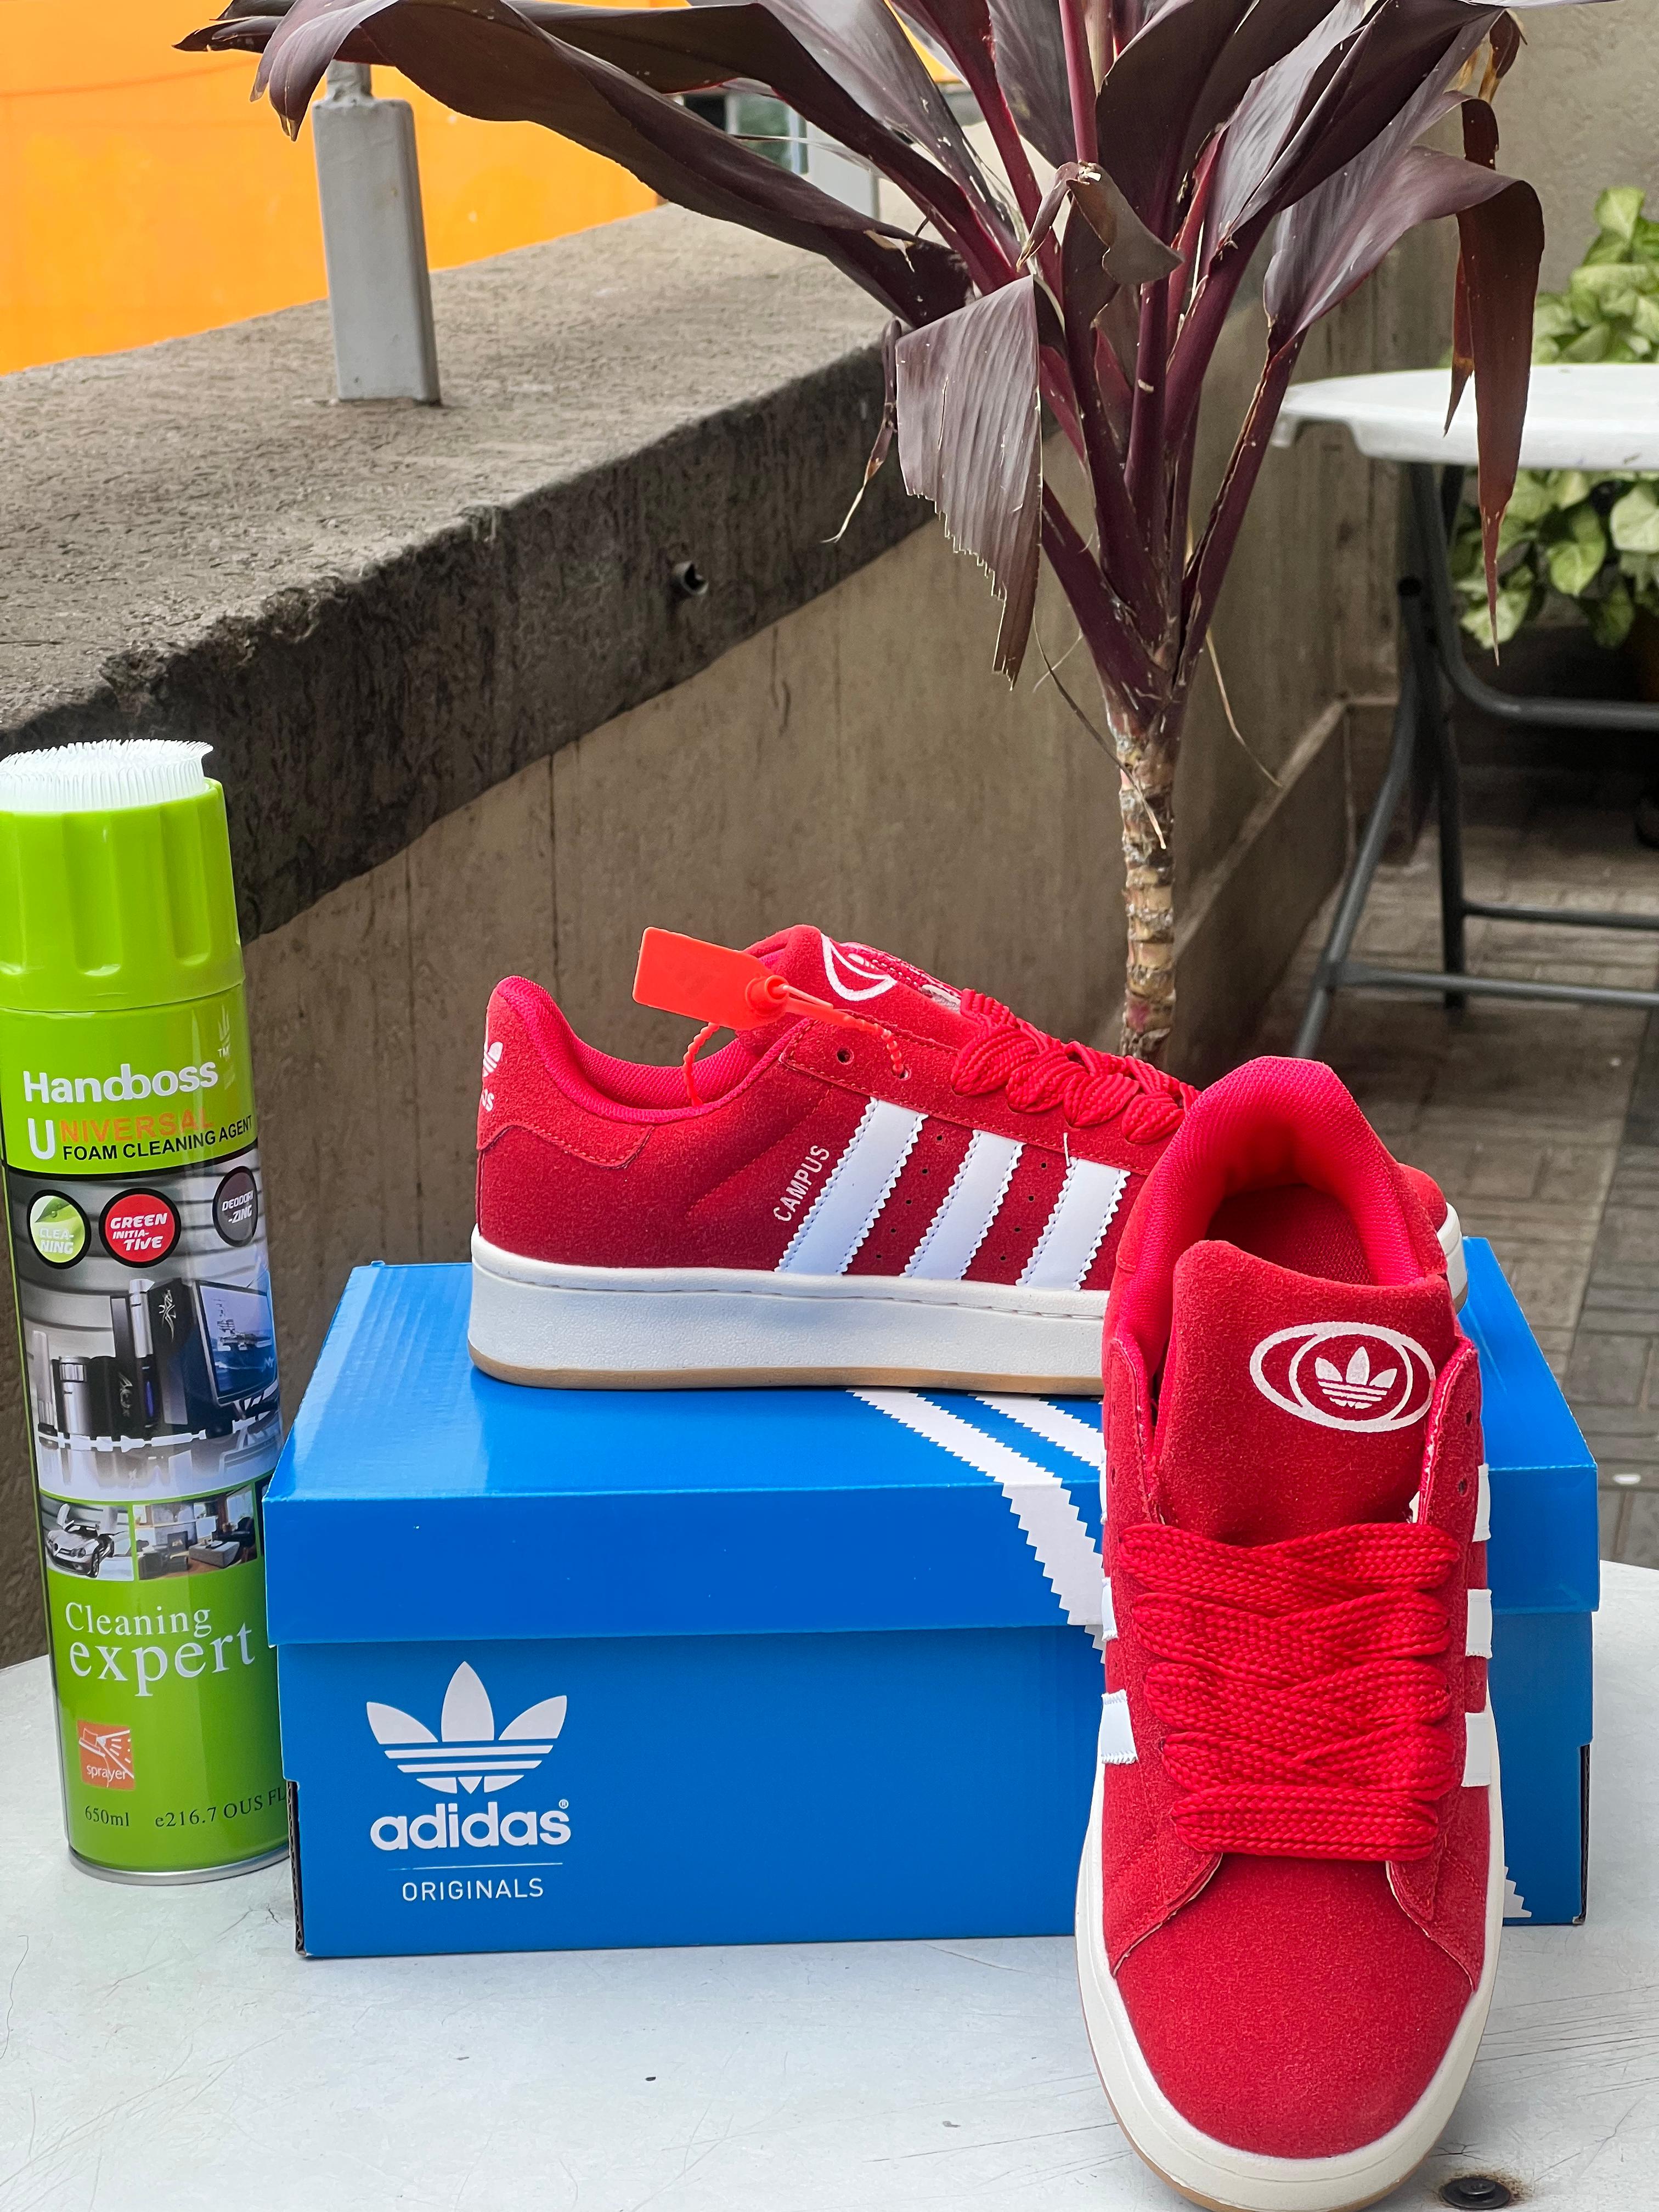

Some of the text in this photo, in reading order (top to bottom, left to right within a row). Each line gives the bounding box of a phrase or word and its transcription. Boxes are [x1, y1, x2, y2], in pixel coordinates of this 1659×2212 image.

[23, 1061, 218, 1103] Handboss
[63, 1115, 252, 1161] FOAM CLEANING AGENT
[773, 1144, 830, 1222] CAMPUS
[110, 1212, 167, 1229] GREEN
[112, 1229, 149, 1240] INITIA-
[41, 1240, 74, 1254] NING
[123, 1235, 163, 1251] TIVE
[65, 1602, 212, 1638] Cleaning
[69, 1622, 256, 1697] expert
[86, 1764, 128, 1782] sprayer
[84, 1805, 129, 1827] 650ml
[155, 1806, 217, 1828] e216.7
[224, 1795, 263, 1819] OUS
[402, 1877, 544, 1902] ORIGINALS
